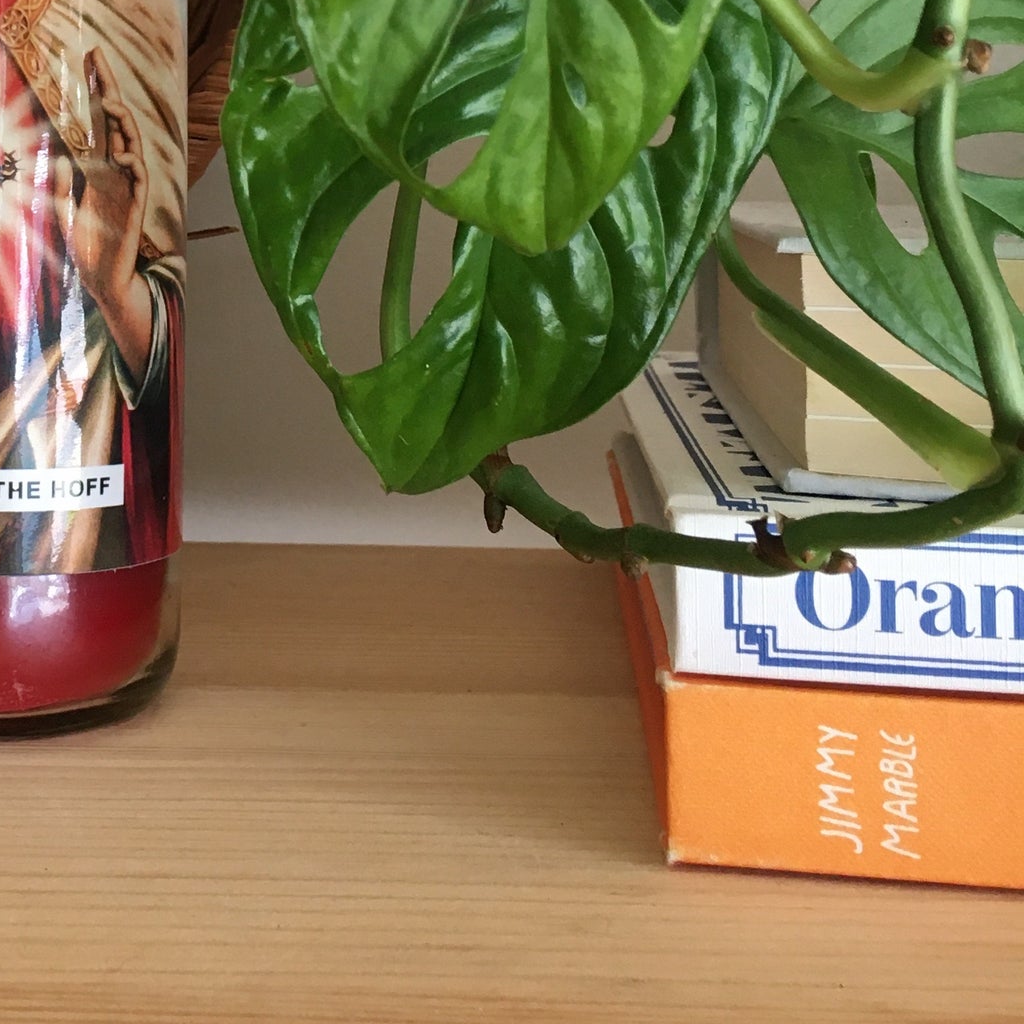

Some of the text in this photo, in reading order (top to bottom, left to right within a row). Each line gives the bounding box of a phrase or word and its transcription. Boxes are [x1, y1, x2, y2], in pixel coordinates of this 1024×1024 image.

[51, 476, 111, 499] HOFF
[794, 560, 1024, 640] Oran
[815, 724, 863, 854] JIMMY
[879, 729, 921, 860] MARBLE
